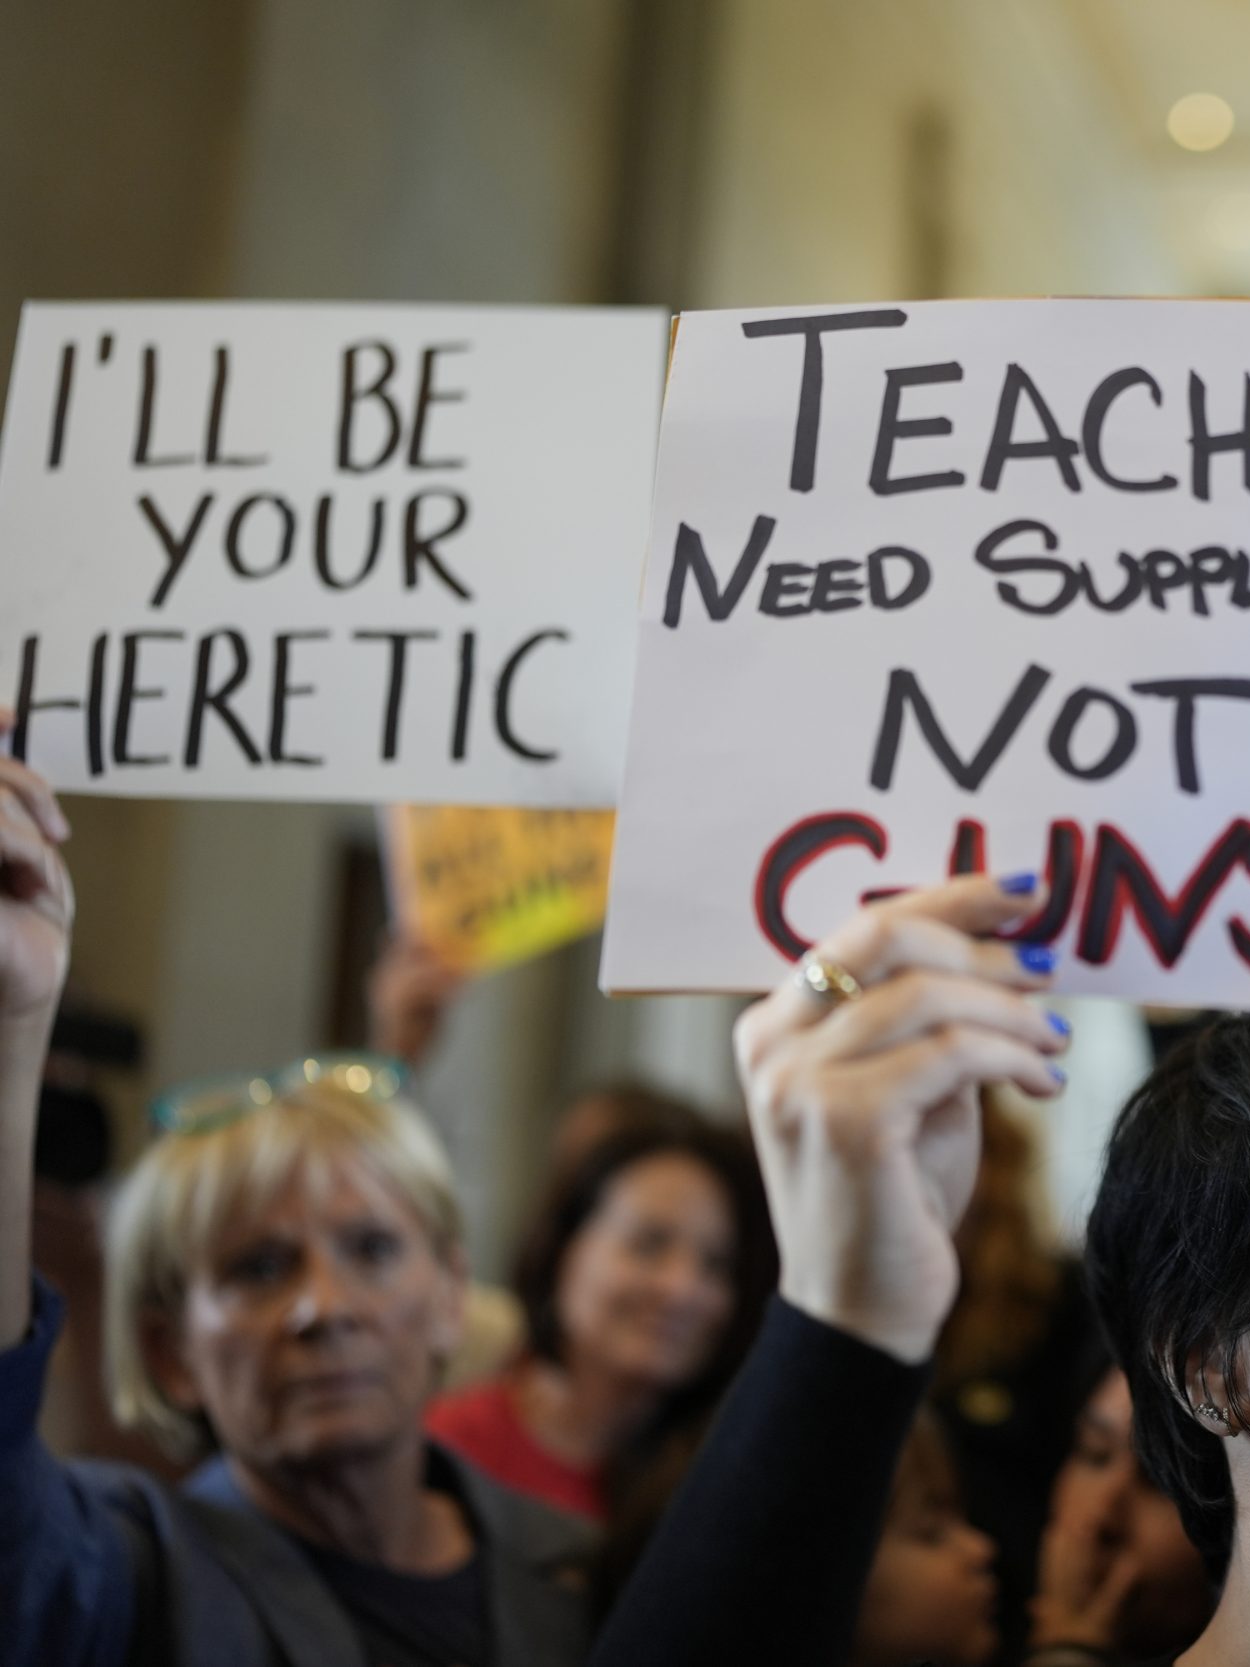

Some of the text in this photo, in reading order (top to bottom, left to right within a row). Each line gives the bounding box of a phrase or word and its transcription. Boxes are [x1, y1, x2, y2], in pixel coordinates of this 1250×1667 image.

[48, 333, 472, 474] I'LL BE
[137, 486, 474, 609] YOUR
[662, 514, 931, 629] NEED
[11, 626, 571, 779] HERETIC
